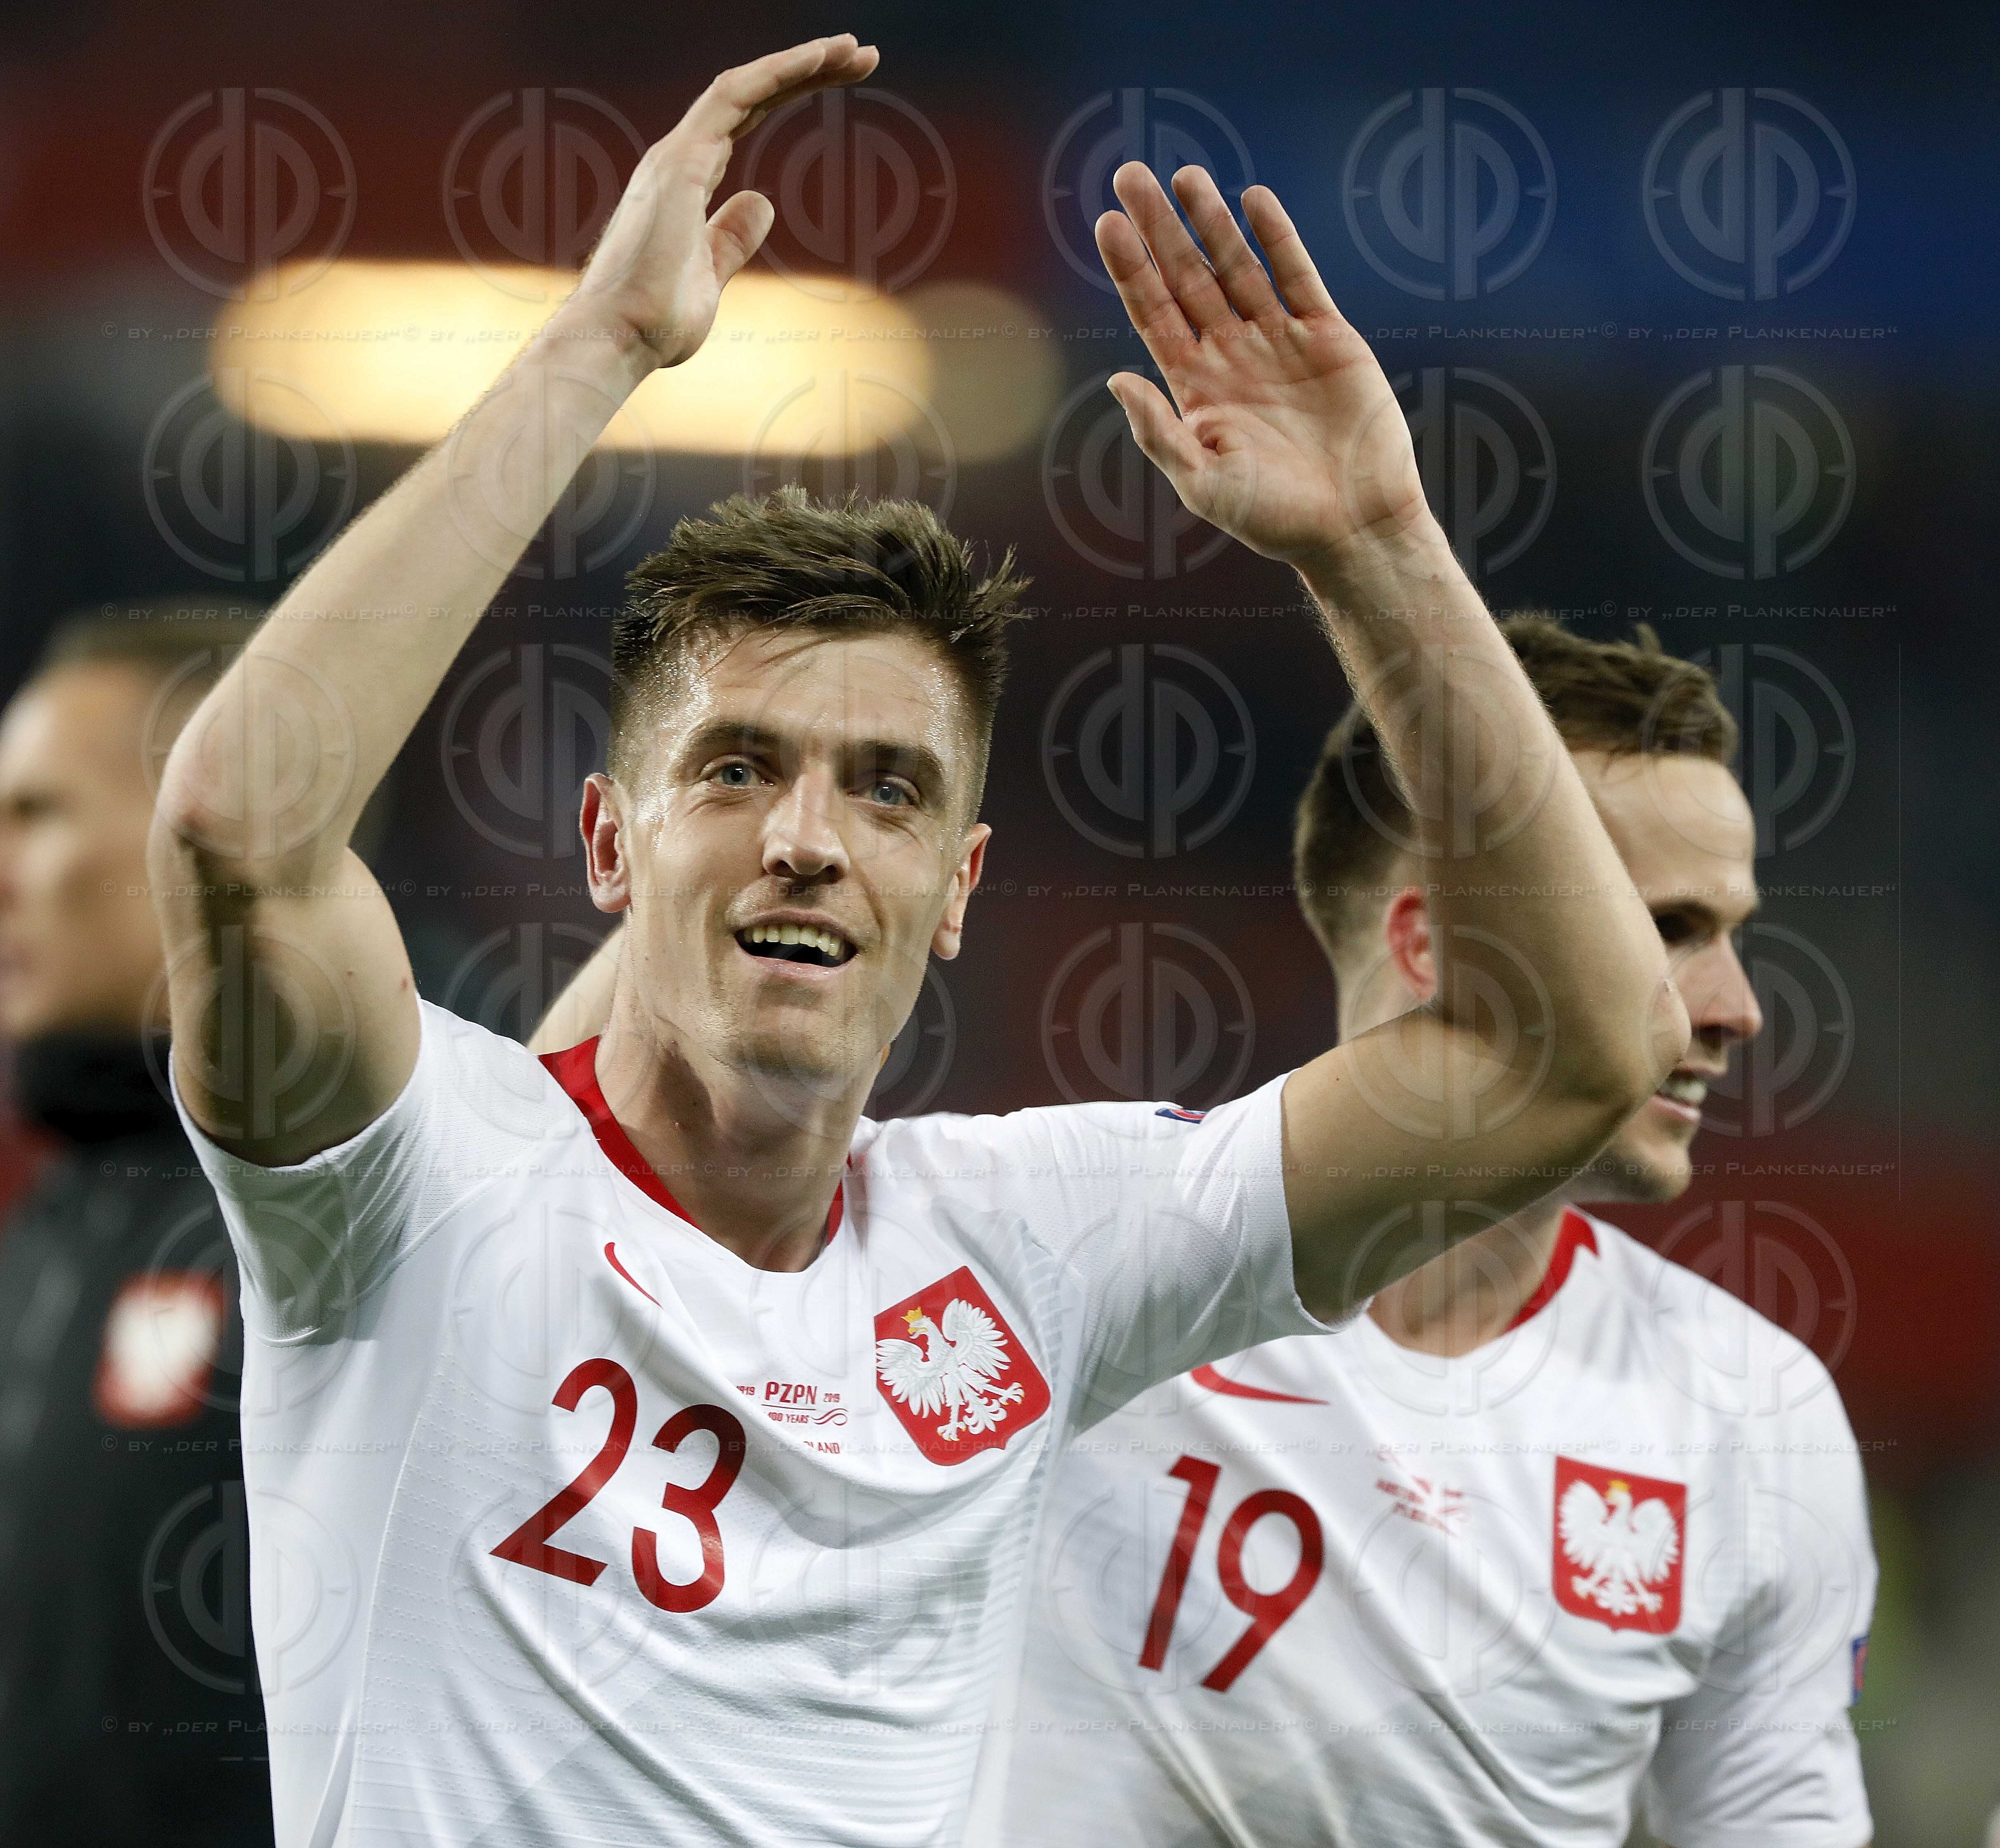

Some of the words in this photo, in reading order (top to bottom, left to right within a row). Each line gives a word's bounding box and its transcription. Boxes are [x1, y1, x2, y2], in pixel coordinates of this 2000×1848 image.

[490, 1358, 746, 1613] 23
[765, 1381, 818, 1405] PZPN
[1138, 1453, 1324, 1693] 19
